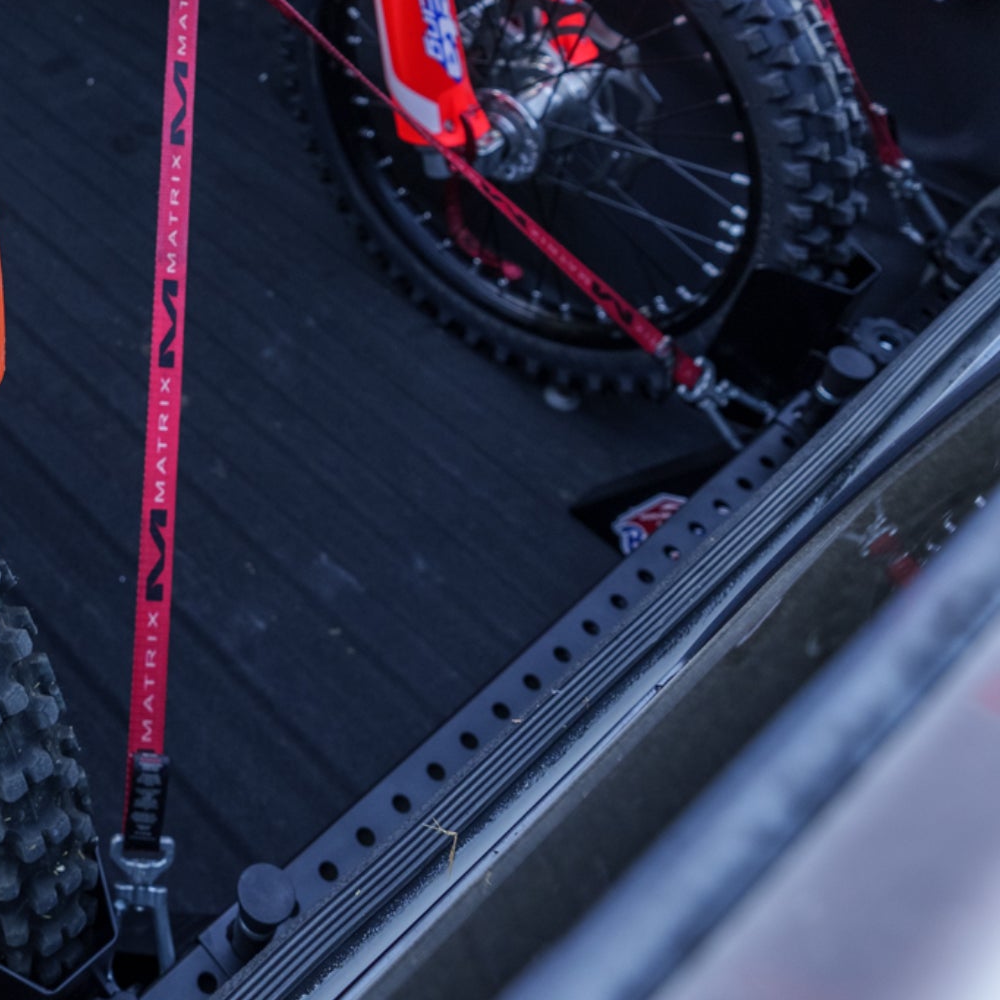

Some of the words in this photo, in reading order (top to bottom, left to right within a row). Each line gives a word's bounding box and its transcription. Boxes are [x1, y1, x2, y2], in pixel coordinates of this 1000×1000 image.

[166, 154, 182, 275] MATRIX
[154, 377, 171, 503] MATRIX
[141, 612, 158, 742] MATRIX
